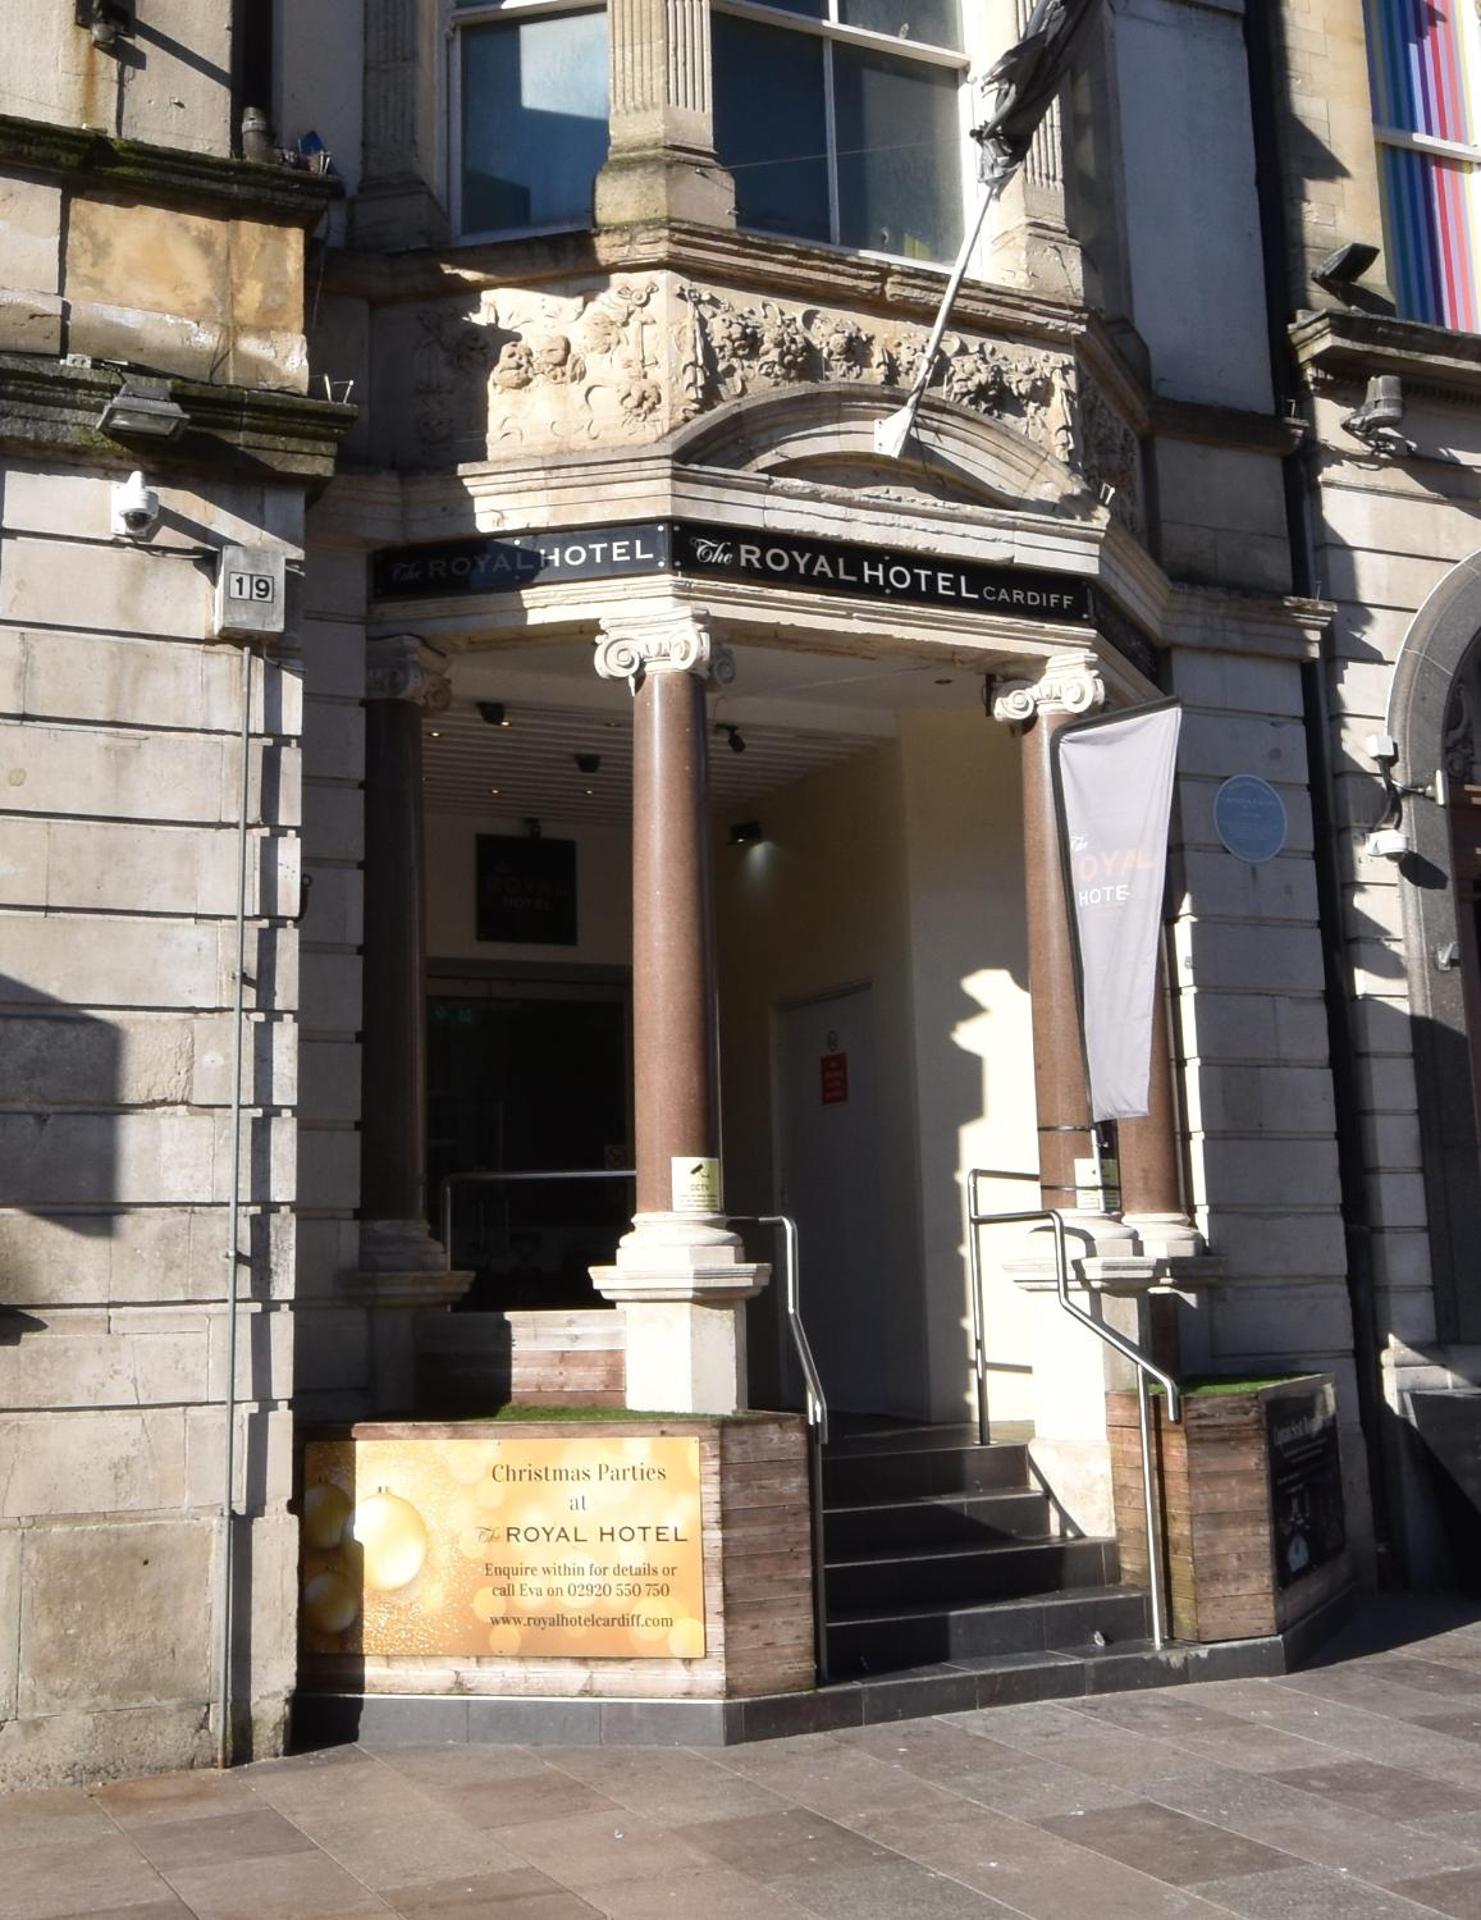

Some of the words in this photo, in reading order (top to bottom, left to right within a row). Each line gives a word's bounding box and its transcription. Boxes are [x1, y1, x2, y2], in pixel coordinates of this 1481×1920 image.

[428, 552, 535, 579] ROYAL
[540, 540, 654, 568] HOTEL
[690, 537, 734, 565] The
[739, 544, 858, 582] ROYAL
[863, 561, 980, 599] HOTEL
[983, 586, 1074, 609] CARDIFF
[235, 576, 270, 598] 19
[1074, 846, 1153, 881] OYAL
[491, 1463, 592, 1483] Christmas
[598, 1462, 667, 1482] Parties
[569, 1495, 588, 1511] at
[474, 1525, 502, 1544] The
[506, 1526, 588, 1542] ROYAL
[599, 1526, 689, 1542] HOTEL
[484, 1562, 538, 1579] Enquire
[542, 1562, 585, 1576] within
[589, 1562, 609, 1576] for
[612, 1562, 658, 1576] details
[662, 1565, 678, 1576] or
[492, 1583, 515, 1597] call
[519, 1583, 543, 1597] Eva
[547, 1586, 564, 1597] on
[567, 1583, 612, 1597] 02920
[616, 1583, 641, 1597] 550
[645, 1583, 671, 1597] 750
[489, 1612, 674, 1630] www.royalhotelcardiff.com
